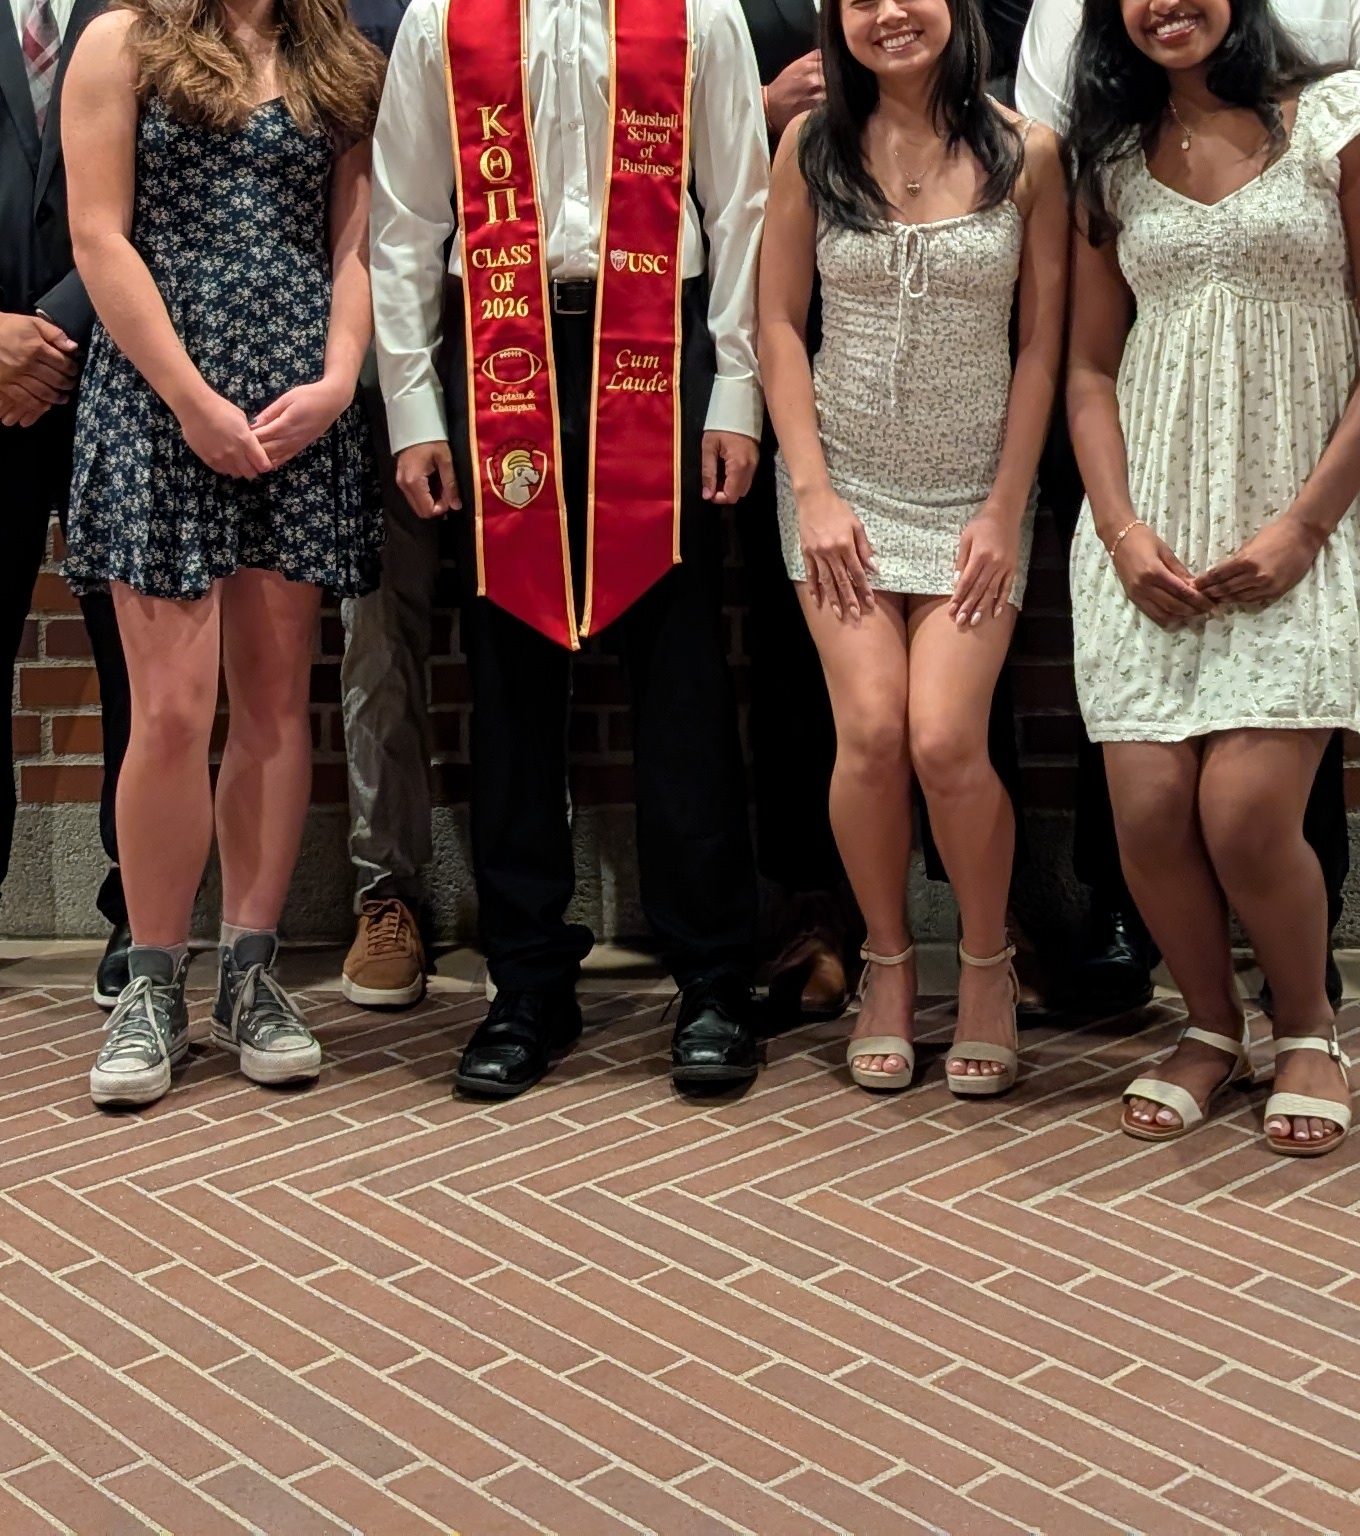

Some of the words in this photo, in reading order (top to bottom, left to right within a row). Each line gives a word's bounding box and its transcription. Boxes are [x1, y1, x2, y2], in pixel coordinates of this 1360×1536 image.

[621, 108, 679, 128] Marshall
[627, 126, 670, 144] School
[640, 144, 656, 159] of
[620, 157, 674, 176] Business
[472, 244, 532, 269] CLASS
[628, 252, 668, 275] USC
[491, 271, 516, 293] OF
[481, 295, 529, 320] 2026
[616, 348, 660, 369] Cum
[606, 371, 668, 393] Laude
